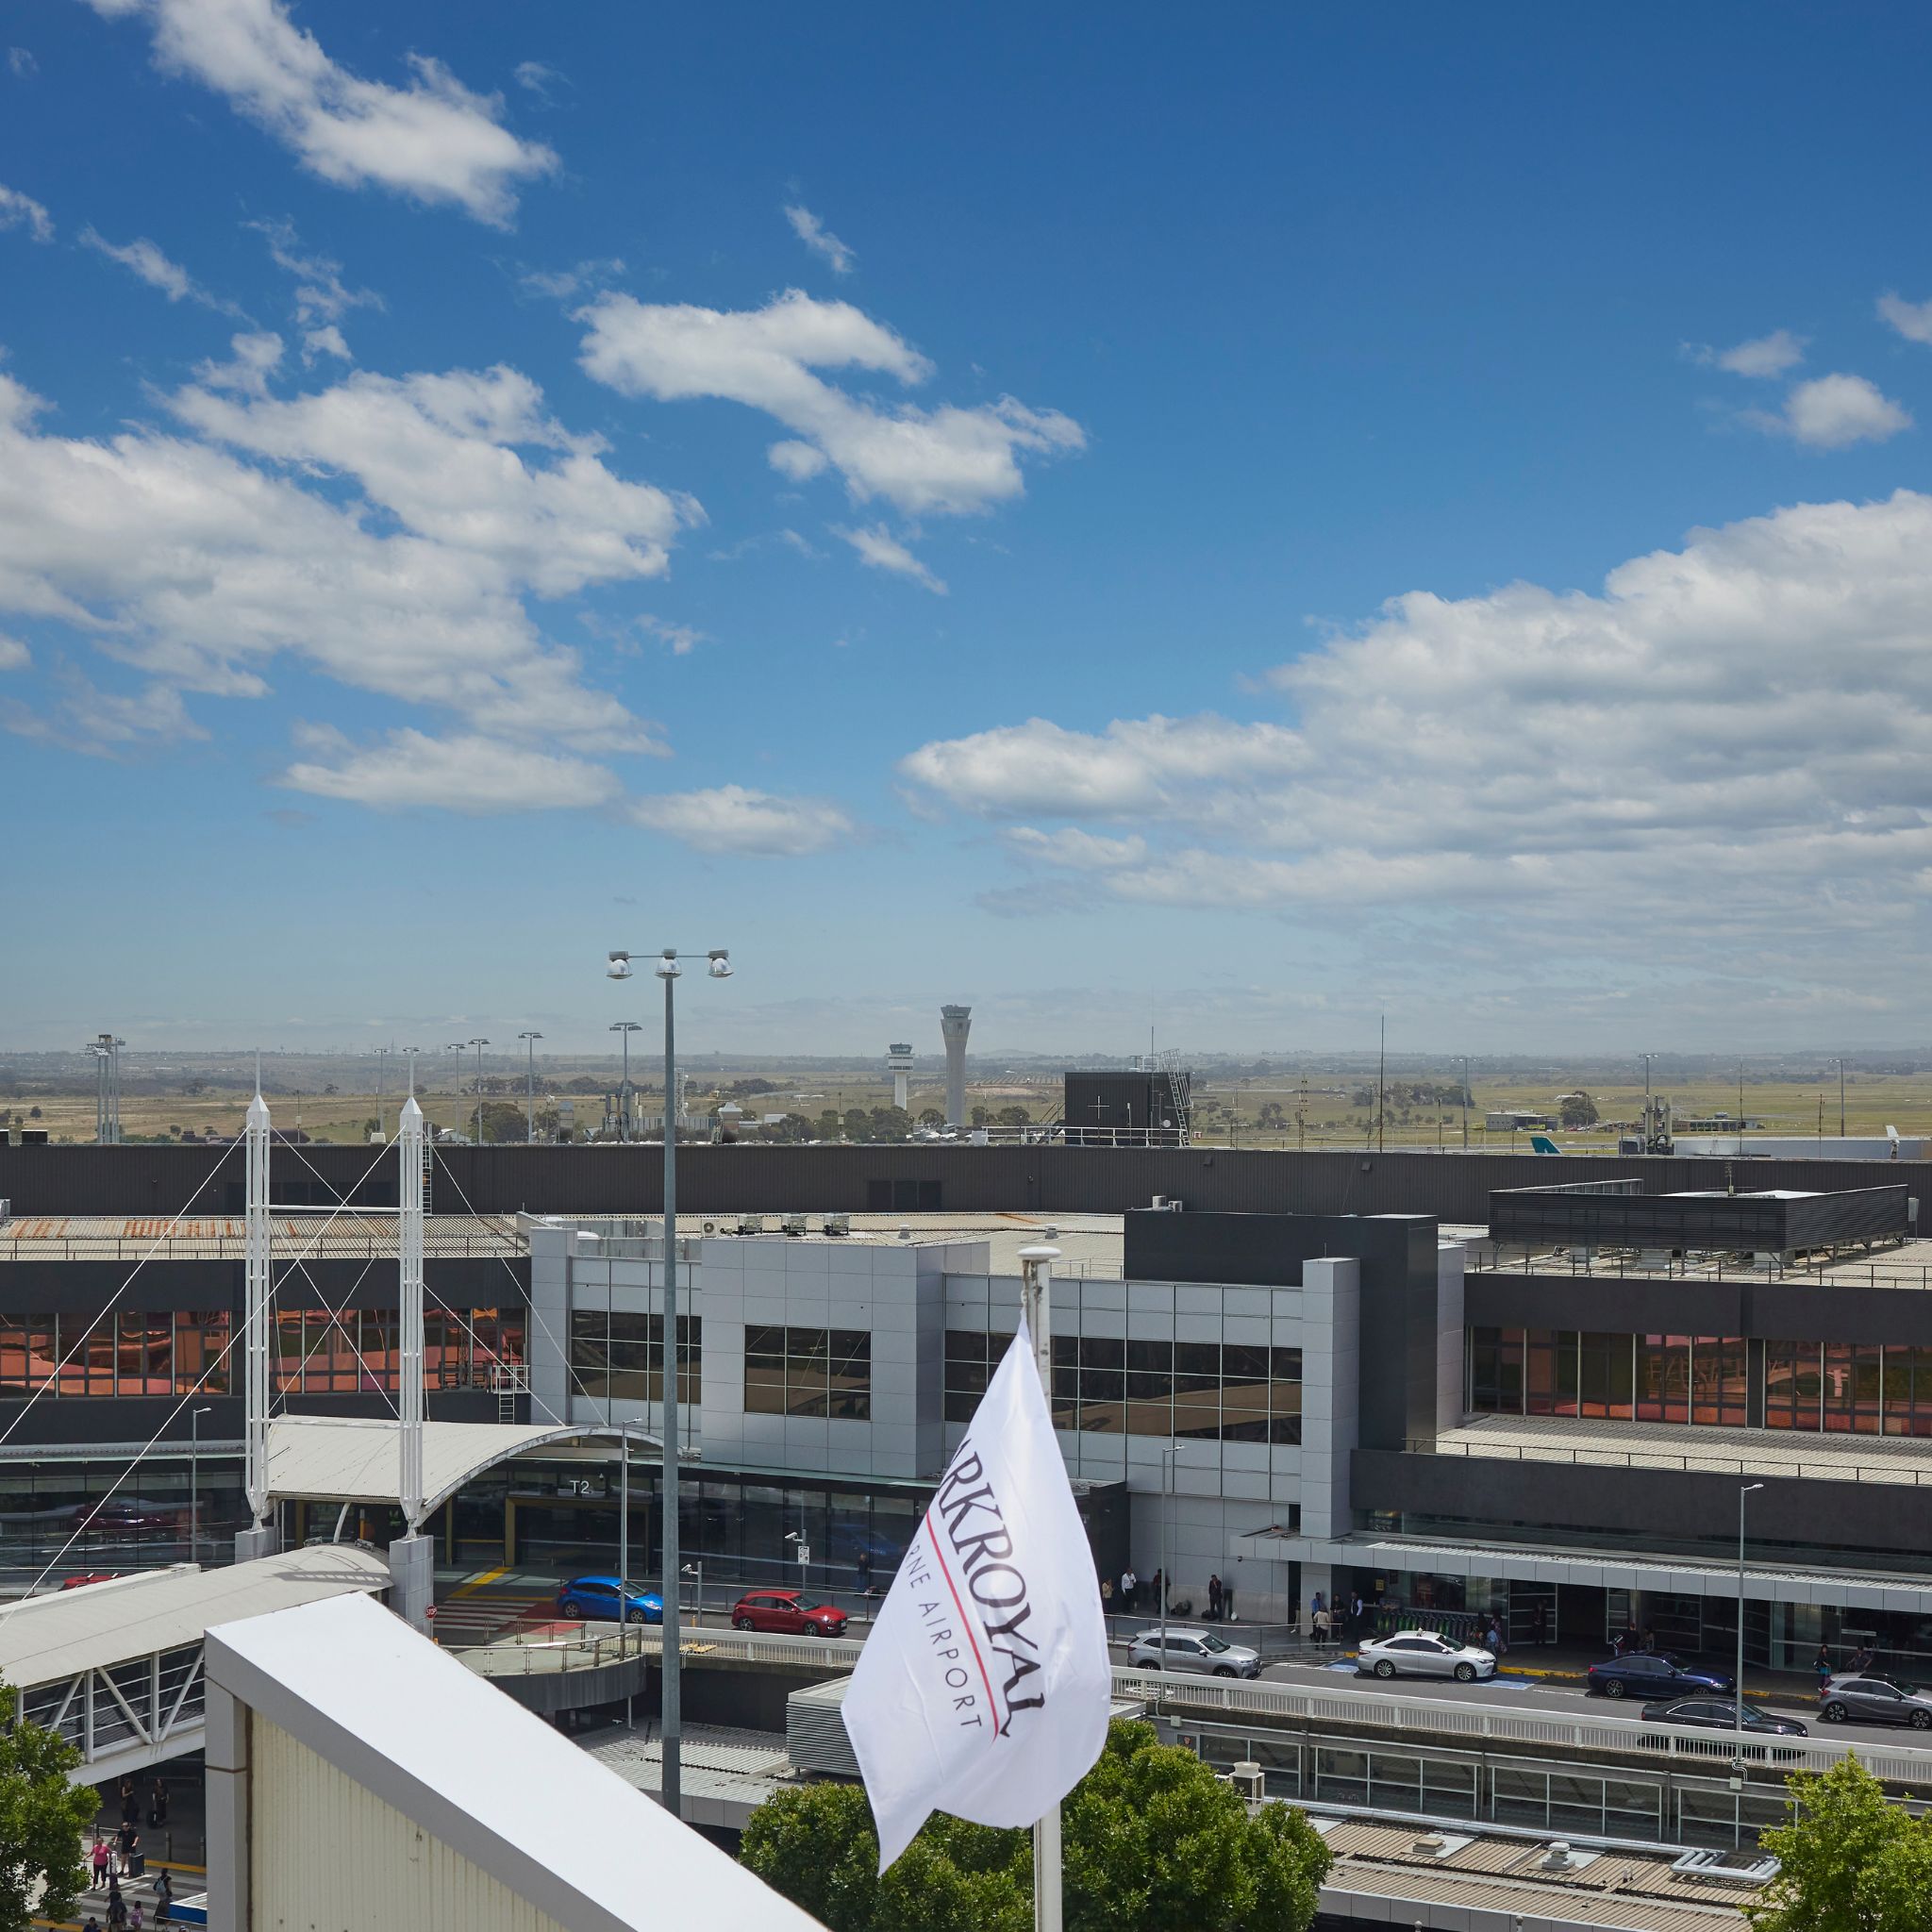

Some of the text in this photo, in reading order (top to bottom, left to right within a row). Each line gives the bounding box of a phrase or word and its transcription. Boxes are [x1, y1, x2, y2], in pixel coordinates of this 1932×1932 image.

[570, 1480, 591, 1494] T2
[906, 1539, 982, 1728] RNE AIRPORT
